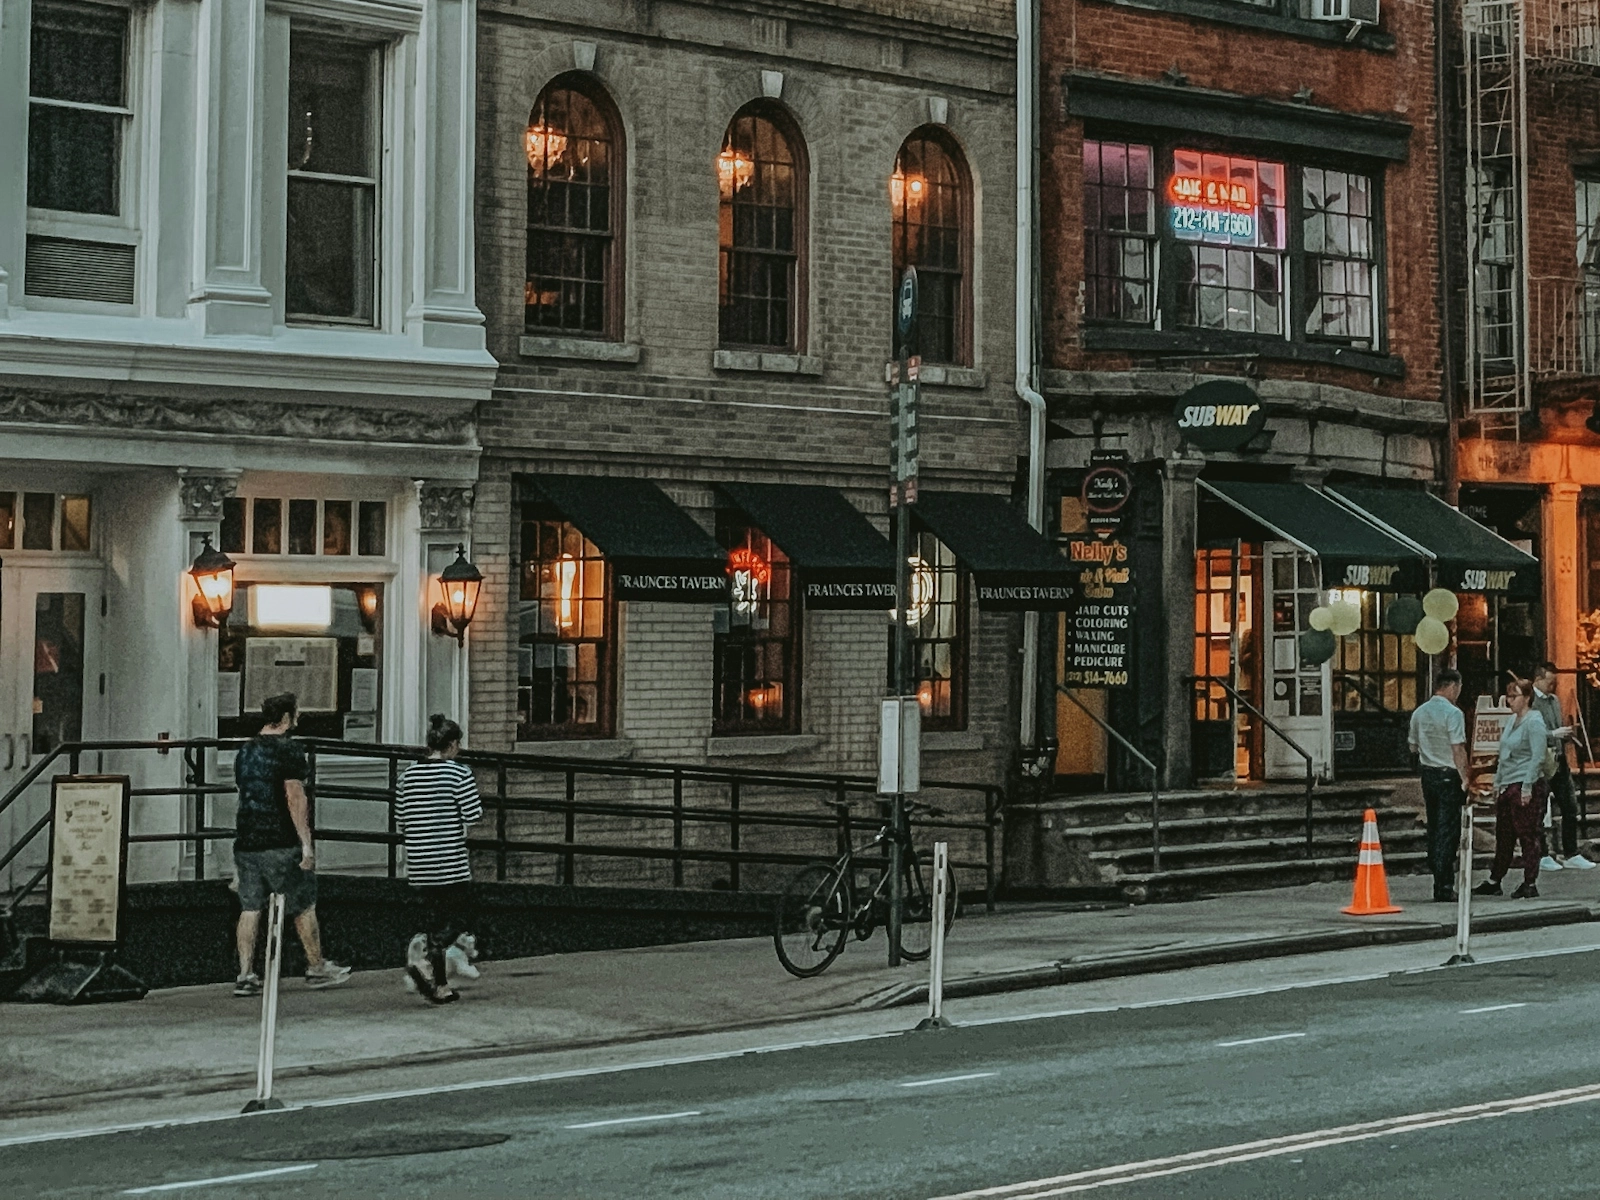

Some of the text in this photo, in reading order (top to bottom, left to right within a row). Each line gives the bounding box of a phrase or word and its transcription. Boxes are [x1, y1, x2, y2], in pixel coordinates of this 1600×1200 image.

[1178, 404, 1260, 428] SUBWAY
[1070, 540, 1127, 566] Nelly's
[618, 574, 677, 589] FRAUNCES
[1343, 564, 1400, 586] SUBWAY
[1460, 568, 1516, 590] SUBWAY
[807, 583, 897, 597] FRAUNCES TAVER
[980, 586, 1031, 600] FRAUNCES
[1103, 605, 1129, 616] CUTS
[1075, 617, 1128, 629] COLORING
[1075, 630, 1115, 642] WAXING
[1074, 643, 1126, 655] MANICURE
[1074, 655, 1123, 667] PEDICURE
